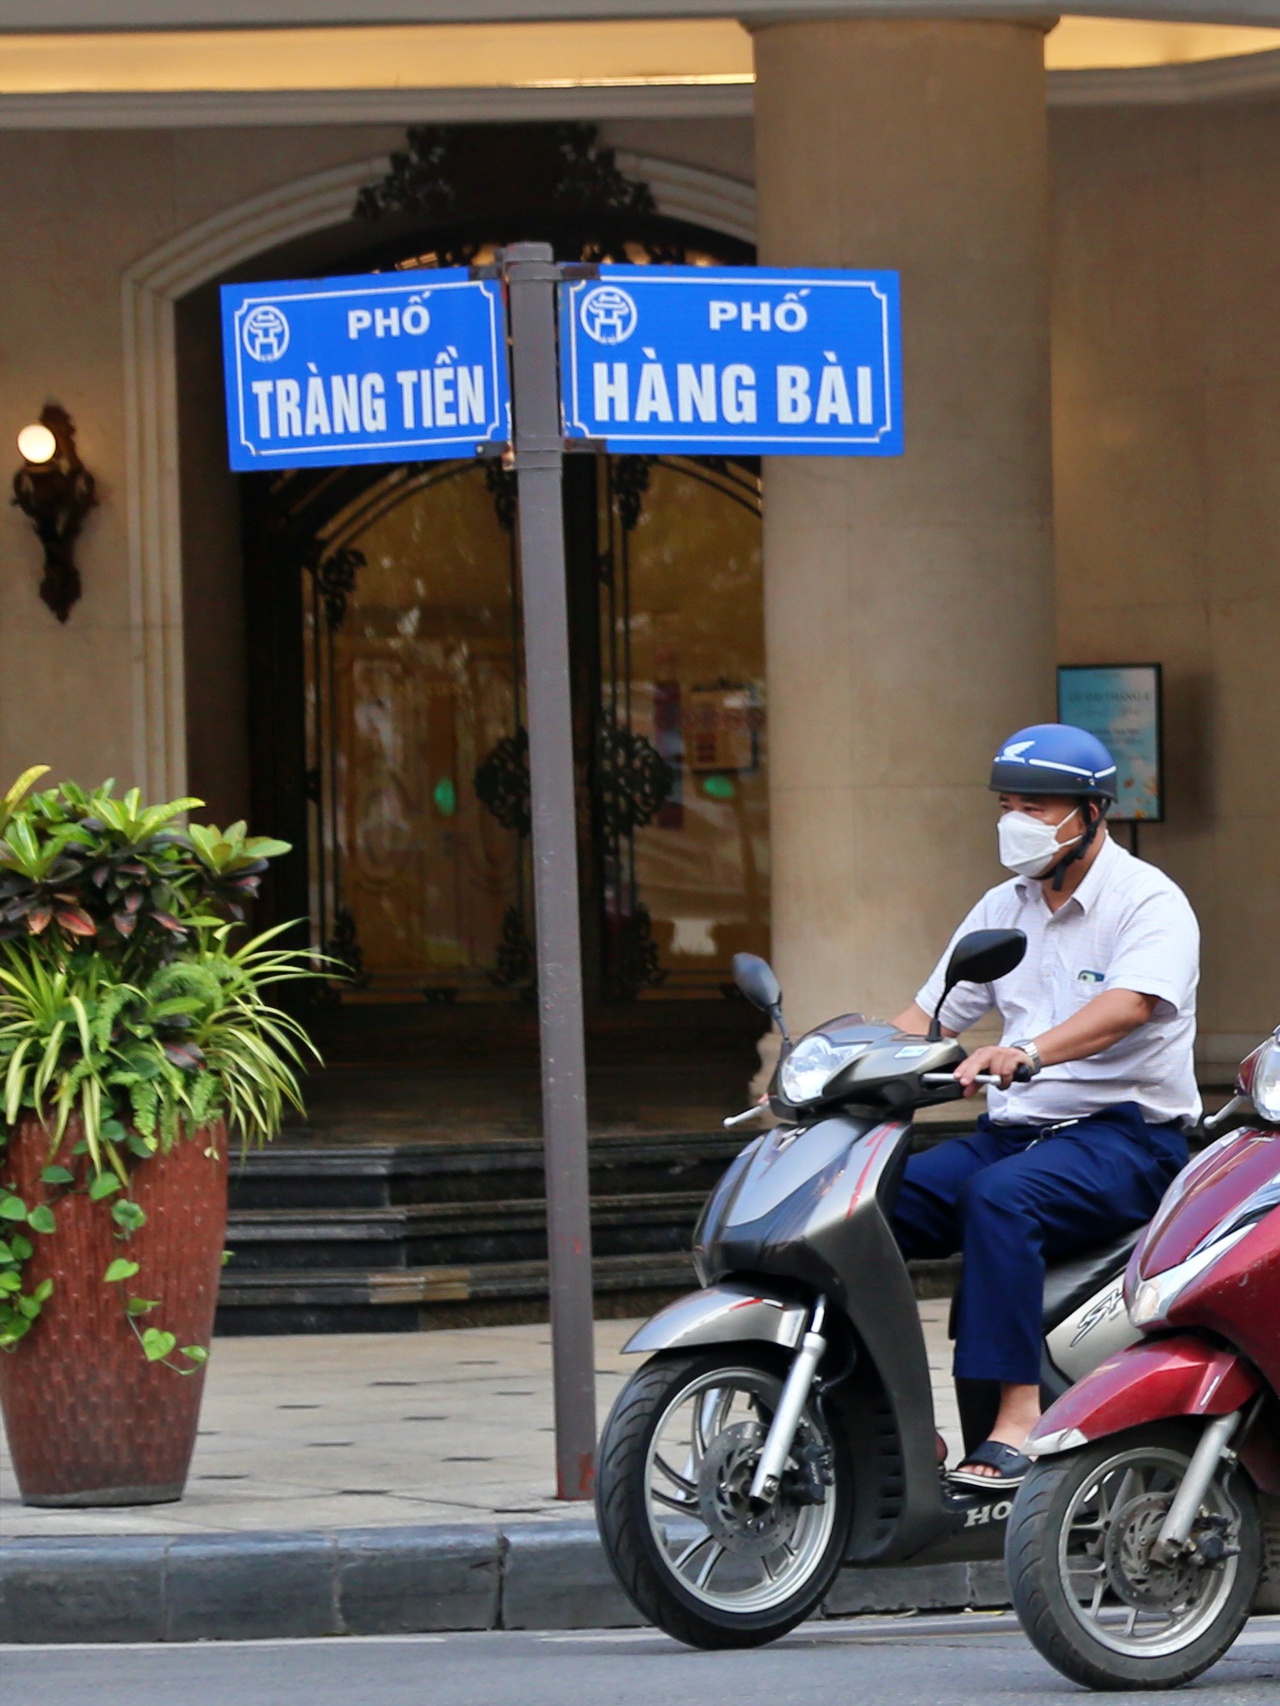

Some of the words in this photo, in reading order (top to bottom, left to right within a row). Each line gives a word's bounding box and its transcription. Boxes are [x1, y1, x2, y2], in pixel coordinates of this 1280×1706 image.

[347, 291, 431, 340] PHỐ
[709, 288, 810, 332] PHỐ
[251, 362, 387, 439] TRÀNG
[396, 345, 486, 429] TIỀN
[593, 346, 757, 424] HÀNG
[776, 350, 873, 425] BÀI
